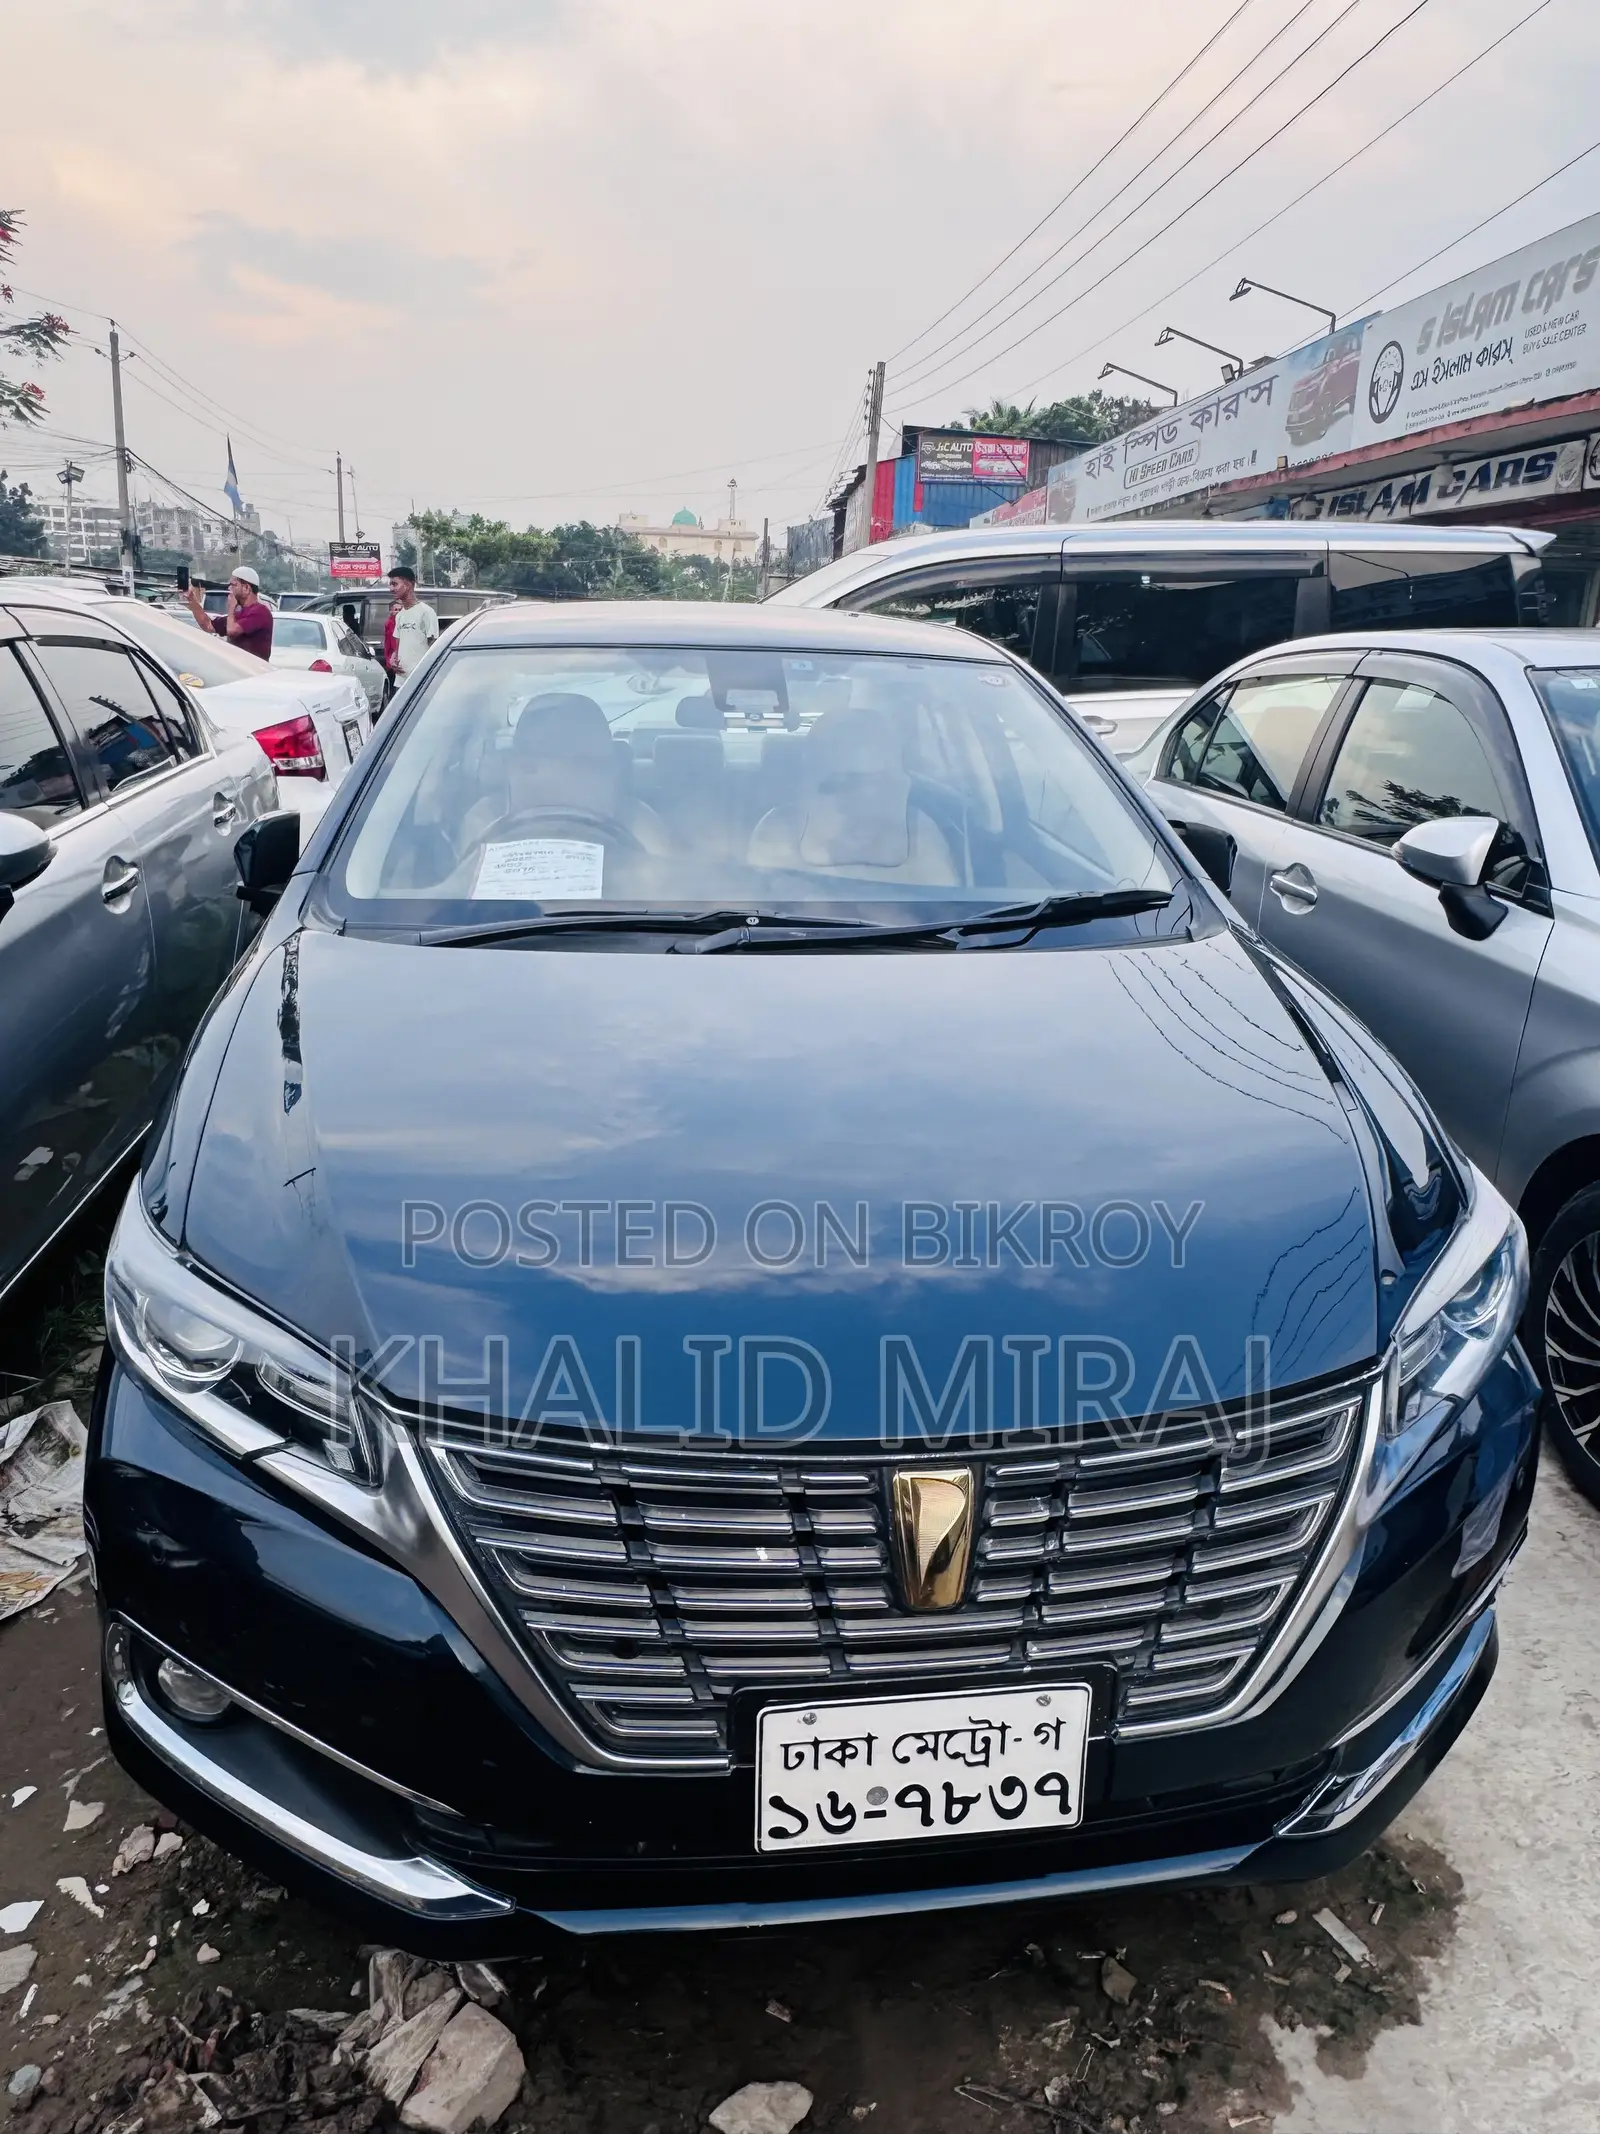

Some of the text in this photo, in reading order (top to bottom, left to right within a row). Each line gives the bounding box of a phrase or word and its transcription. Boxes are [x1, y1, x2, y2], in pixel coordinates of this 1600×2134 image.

[950, 442, 974, 452] AUTO
[1085, 445, 1118, 480] হাই
[780, 1732, 878, 1771] ঢাকা
[767, 1771, 1073, 1839] ১৬-৭৮৩৭
